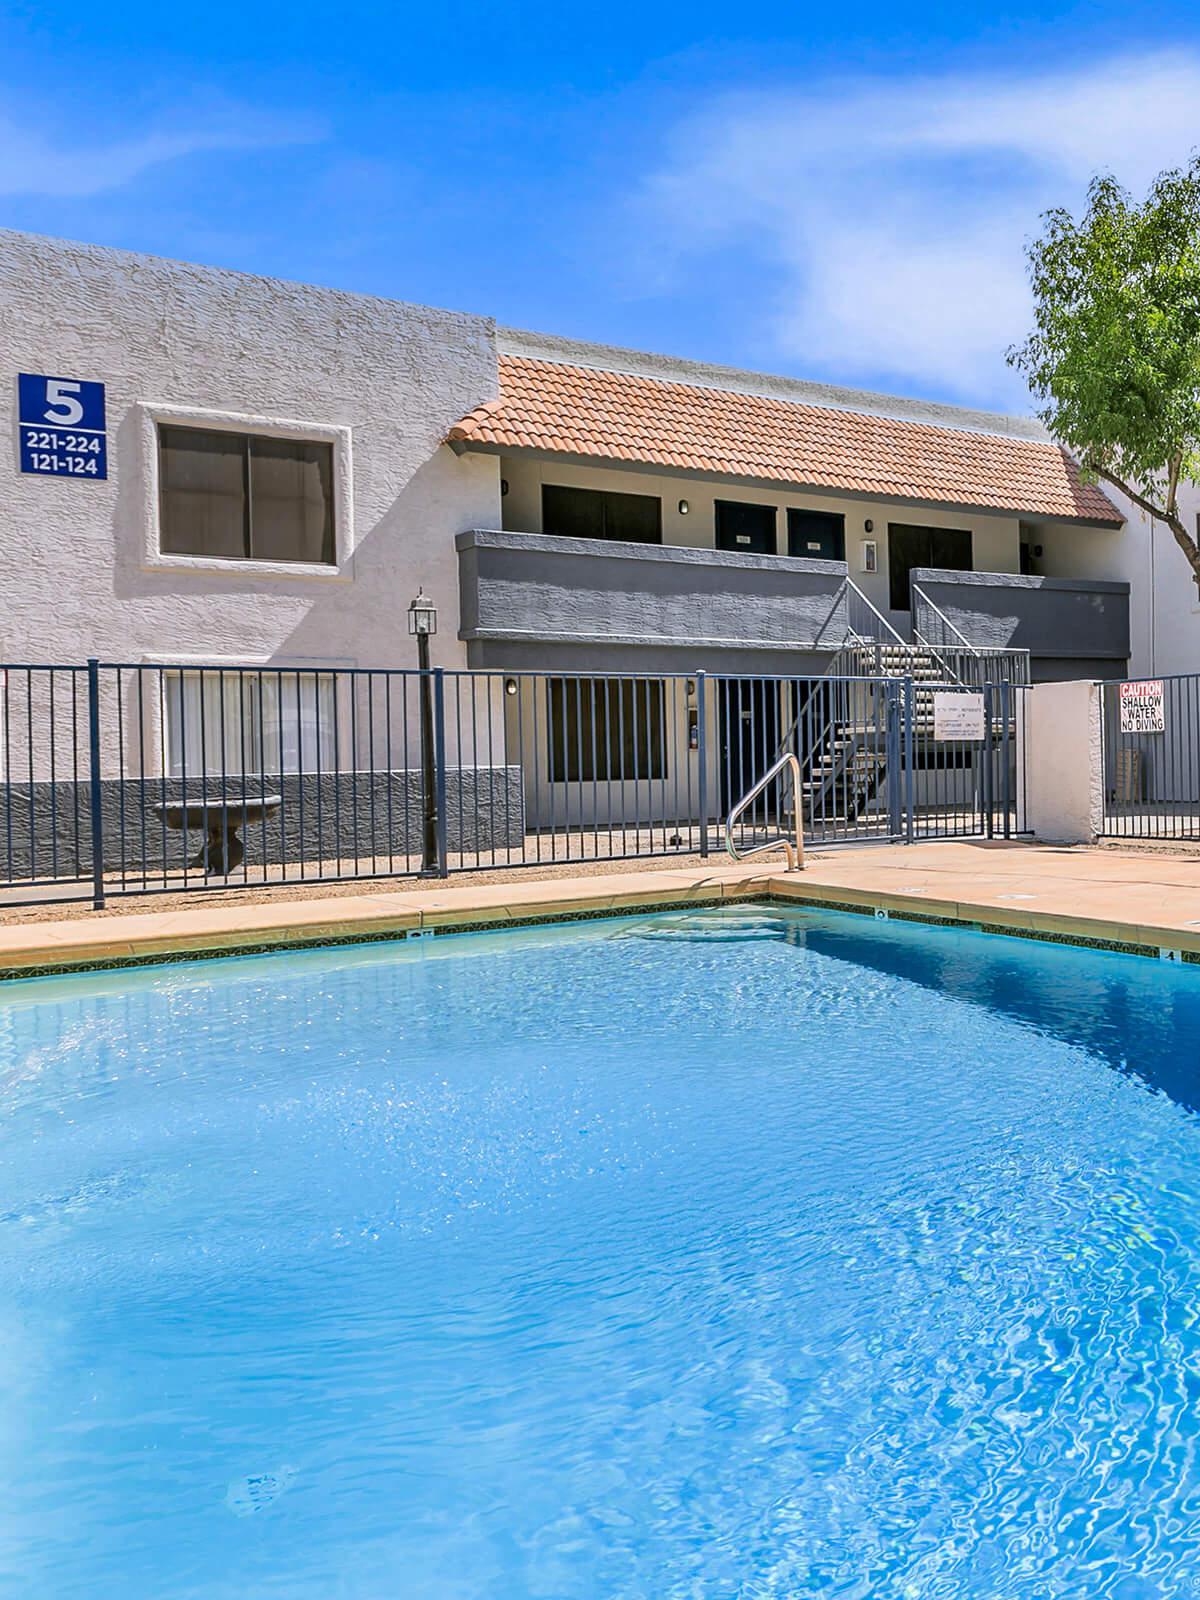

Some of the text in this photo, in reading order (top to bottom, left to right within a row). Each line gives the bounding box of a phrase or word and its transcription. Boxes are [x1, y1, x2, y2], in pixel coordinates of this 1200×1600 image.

[43, 379, 84, 425] 5
[27, 431, 101, 454] 221-224
[30, 453, 98, 475] 121-124
[1122, 681, 1162, 697] CAUTION
[1122, 696, 1161, 709] SHALLOW
[1128, 707, 1156, 719] WATER
[1122, 718, 1163, 731] NO DIVING
